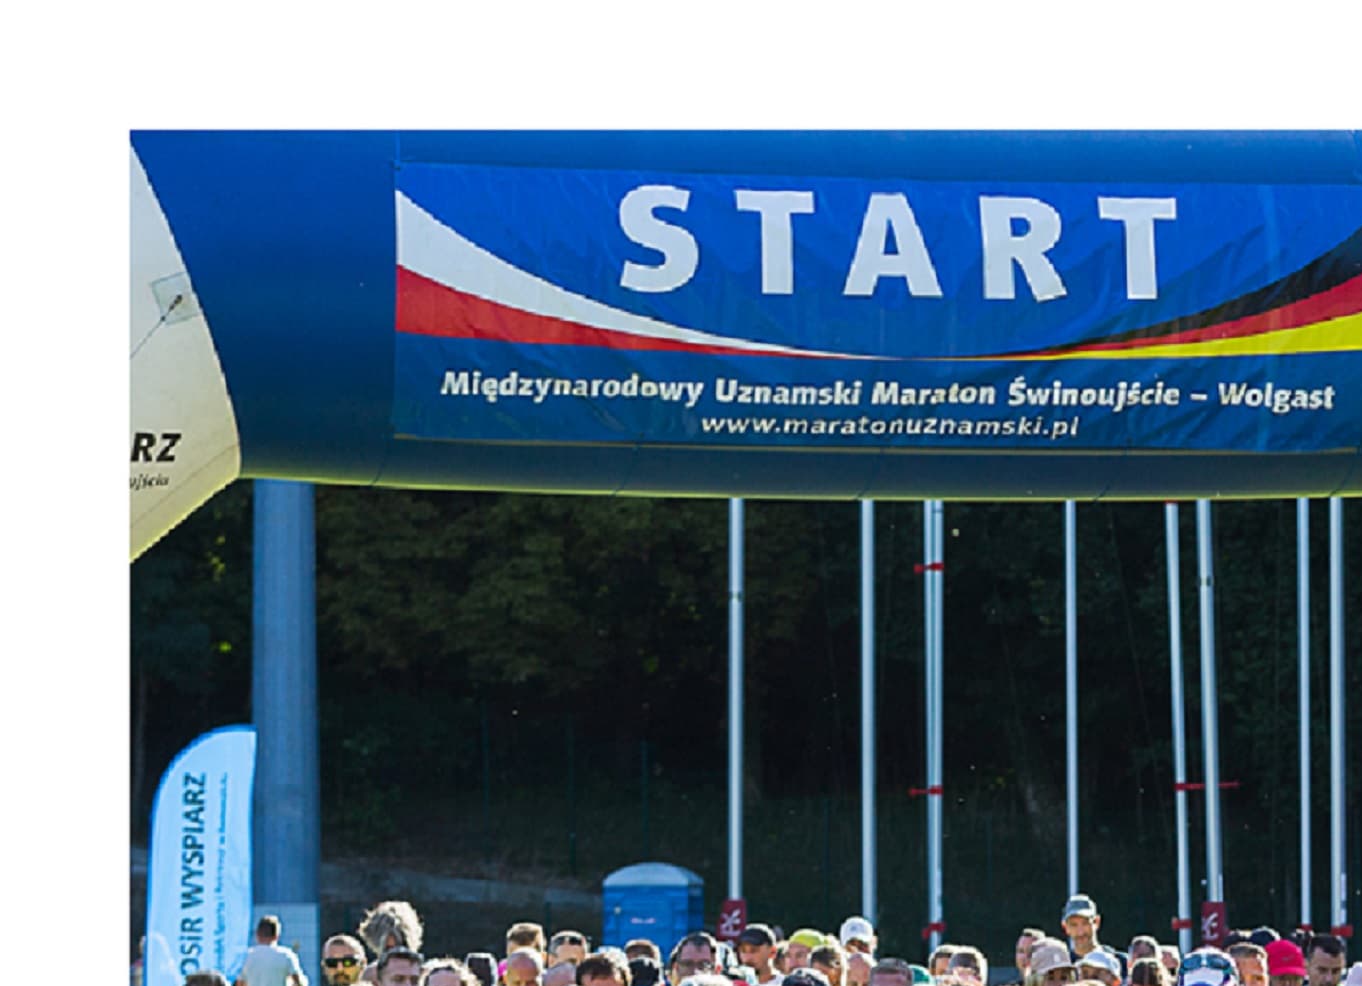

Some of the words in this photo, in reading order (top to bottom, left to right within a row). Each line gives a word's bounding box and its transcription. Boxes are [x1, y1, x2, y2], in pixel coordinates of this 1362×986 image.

[618, 184, 1177, 302] START
[440, 371, 703, 407] Międzynarodowy
[715, 378, 861, 405] Uznamski
[871, 381, 996, 405] Maraton
[1008, 376, 1180, 412] Świnoujście
[1217, 382, 1335, 412] Wolgast
[702, 415, 1079, 439] www.maratonuznamski.pl
[180, 772, 206, 910] WYSPIARZ
[178, 917, 204, 976] OSiR
